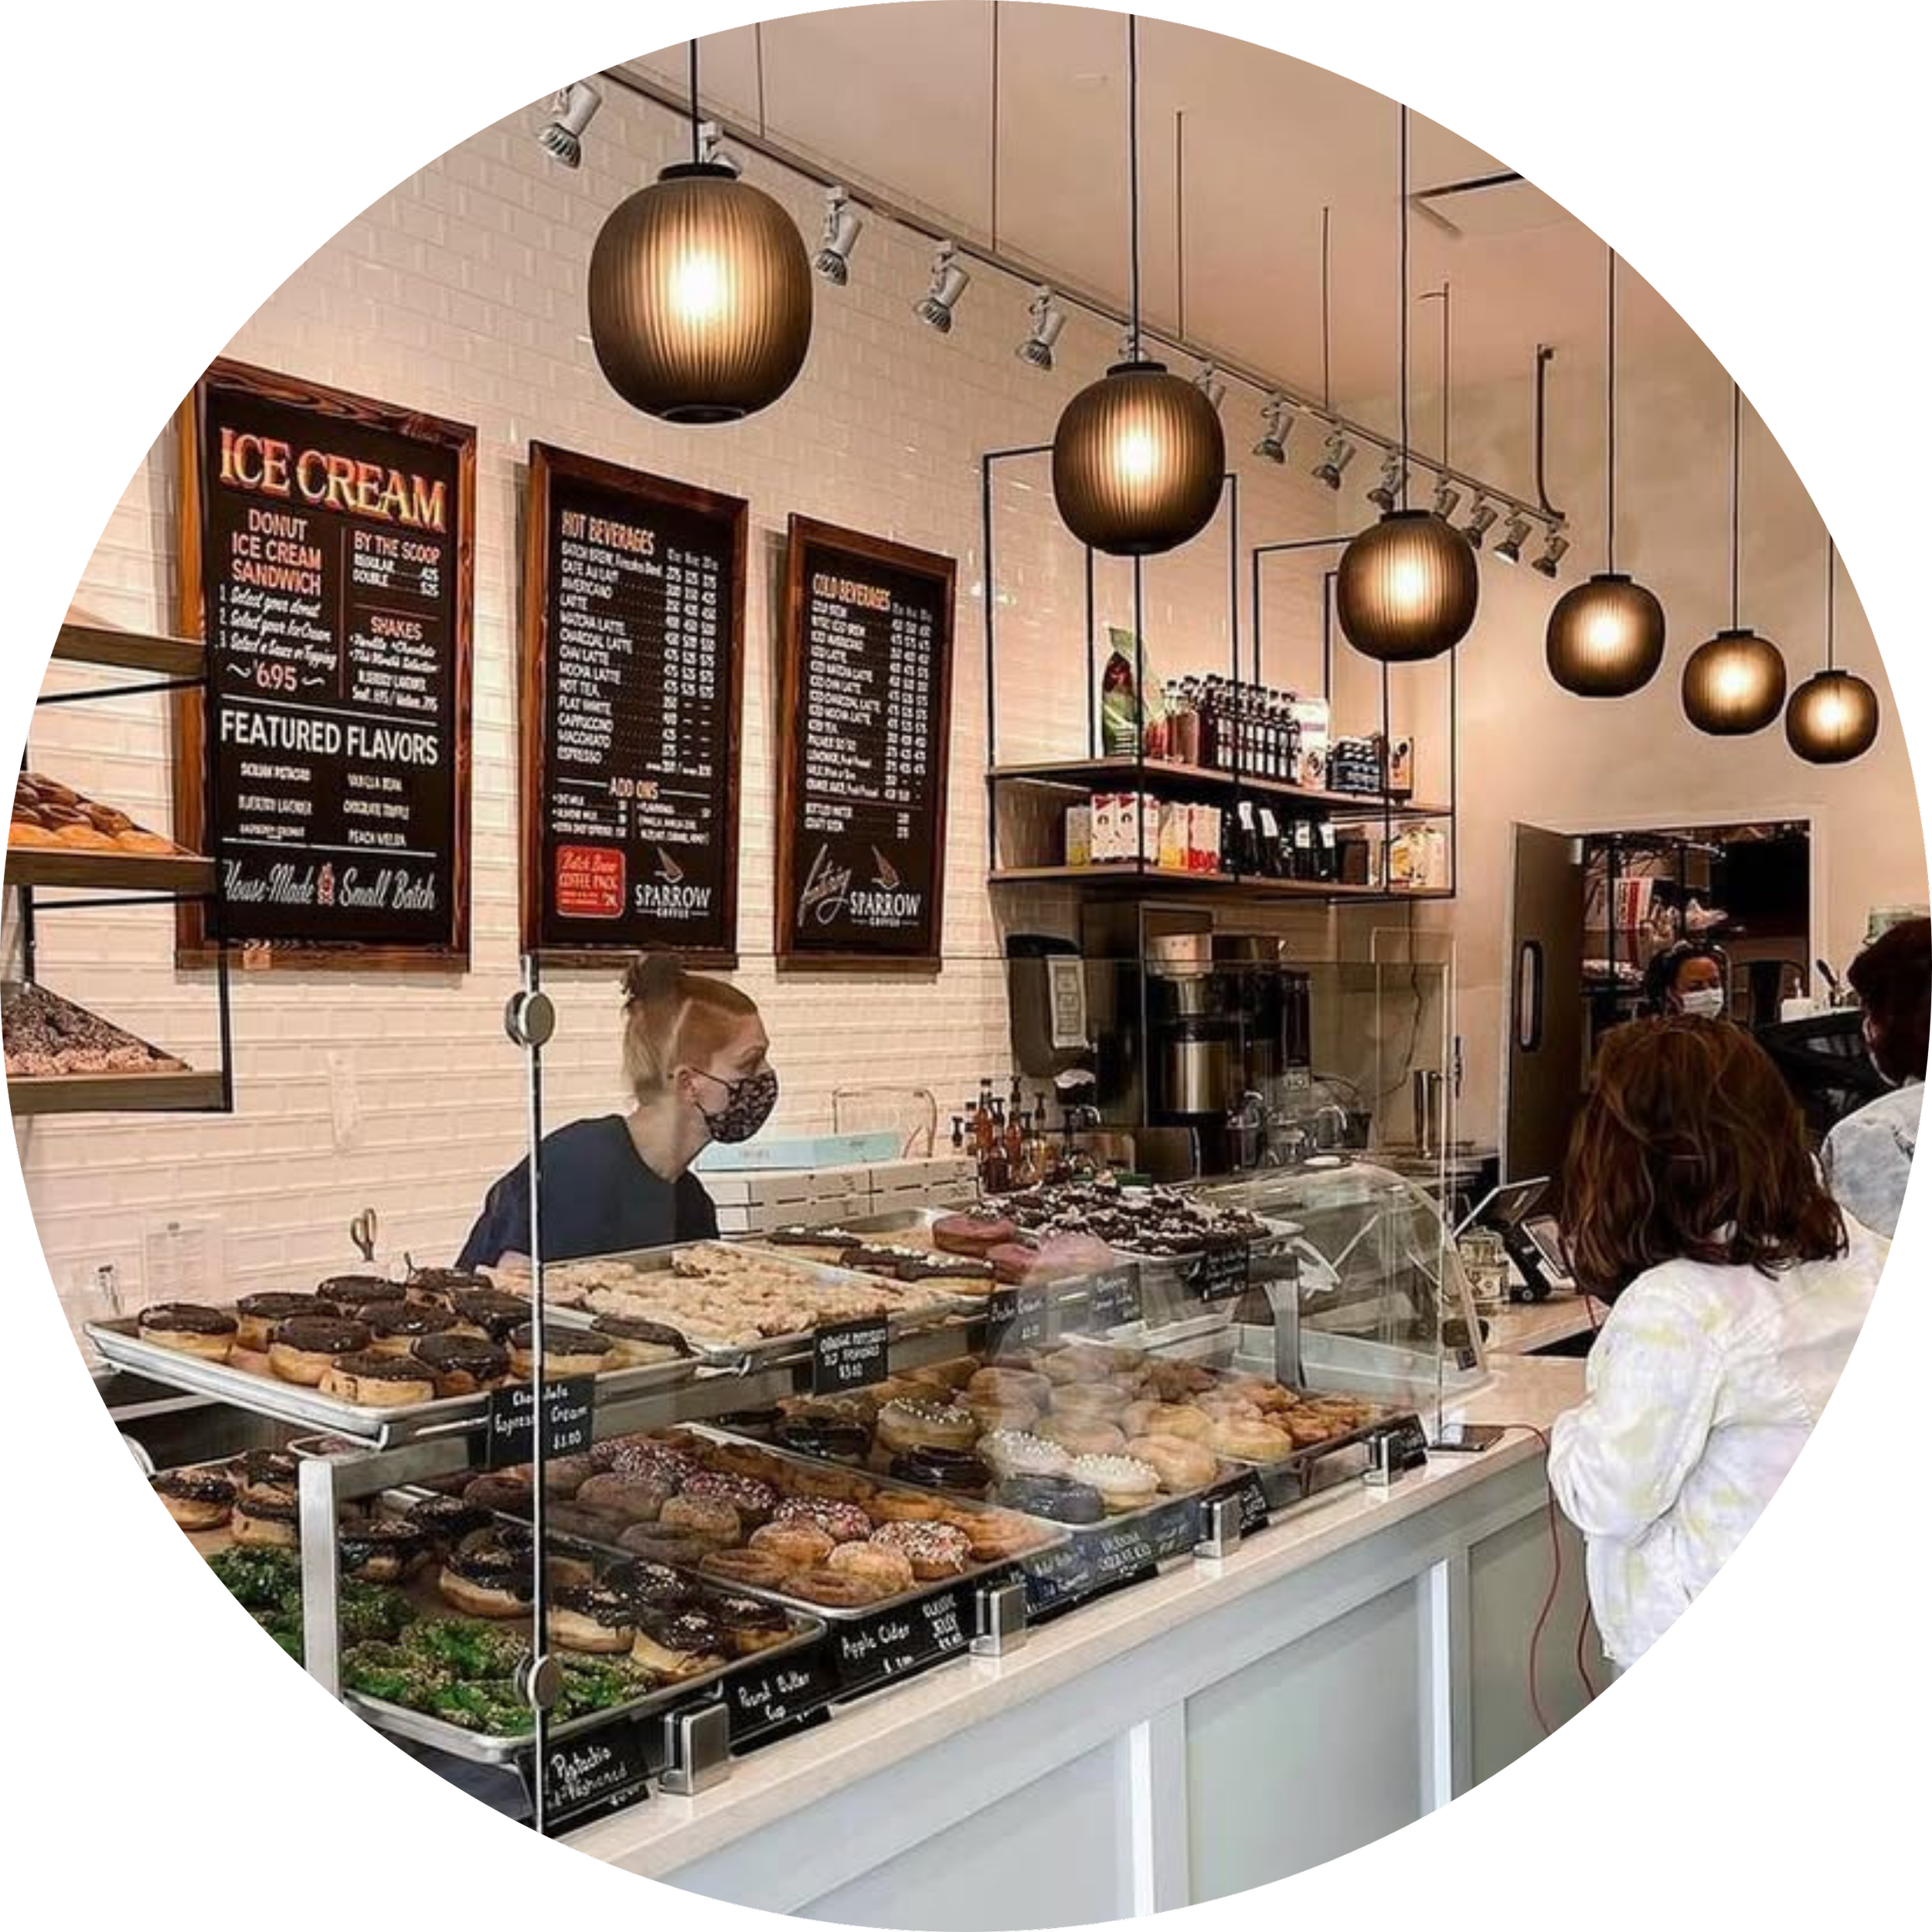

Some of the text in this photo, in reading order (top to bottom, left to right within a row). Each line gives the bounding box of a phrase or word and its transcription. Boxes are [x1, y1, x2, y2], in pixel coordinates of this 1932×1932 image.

[220, 427, 447, 533] ICE CREAM
[249, 509, 307, 541] DONUT
[561, 510, 655, 556] HOT BEVERAGES
[233, 532, 321, 570] ICE CREAM
[355, 530, 441, 566] BY THE SCOOP
[232, 559, 321, 596] SANDWICH
[371, 616, 423, 641] SHAKES
[221, 710, 439, 766] FEATURED FLAVORS
[609, 777, 634, 798] ADD
[338, 866, 436, 910] Small Batch
[559, 872, 590, 890] COFFEE
[635, 884, 711, 910] SPARROW
[850, 891, 921, 917] SPARROW
[841, 1631, 877, 1659] Apple
